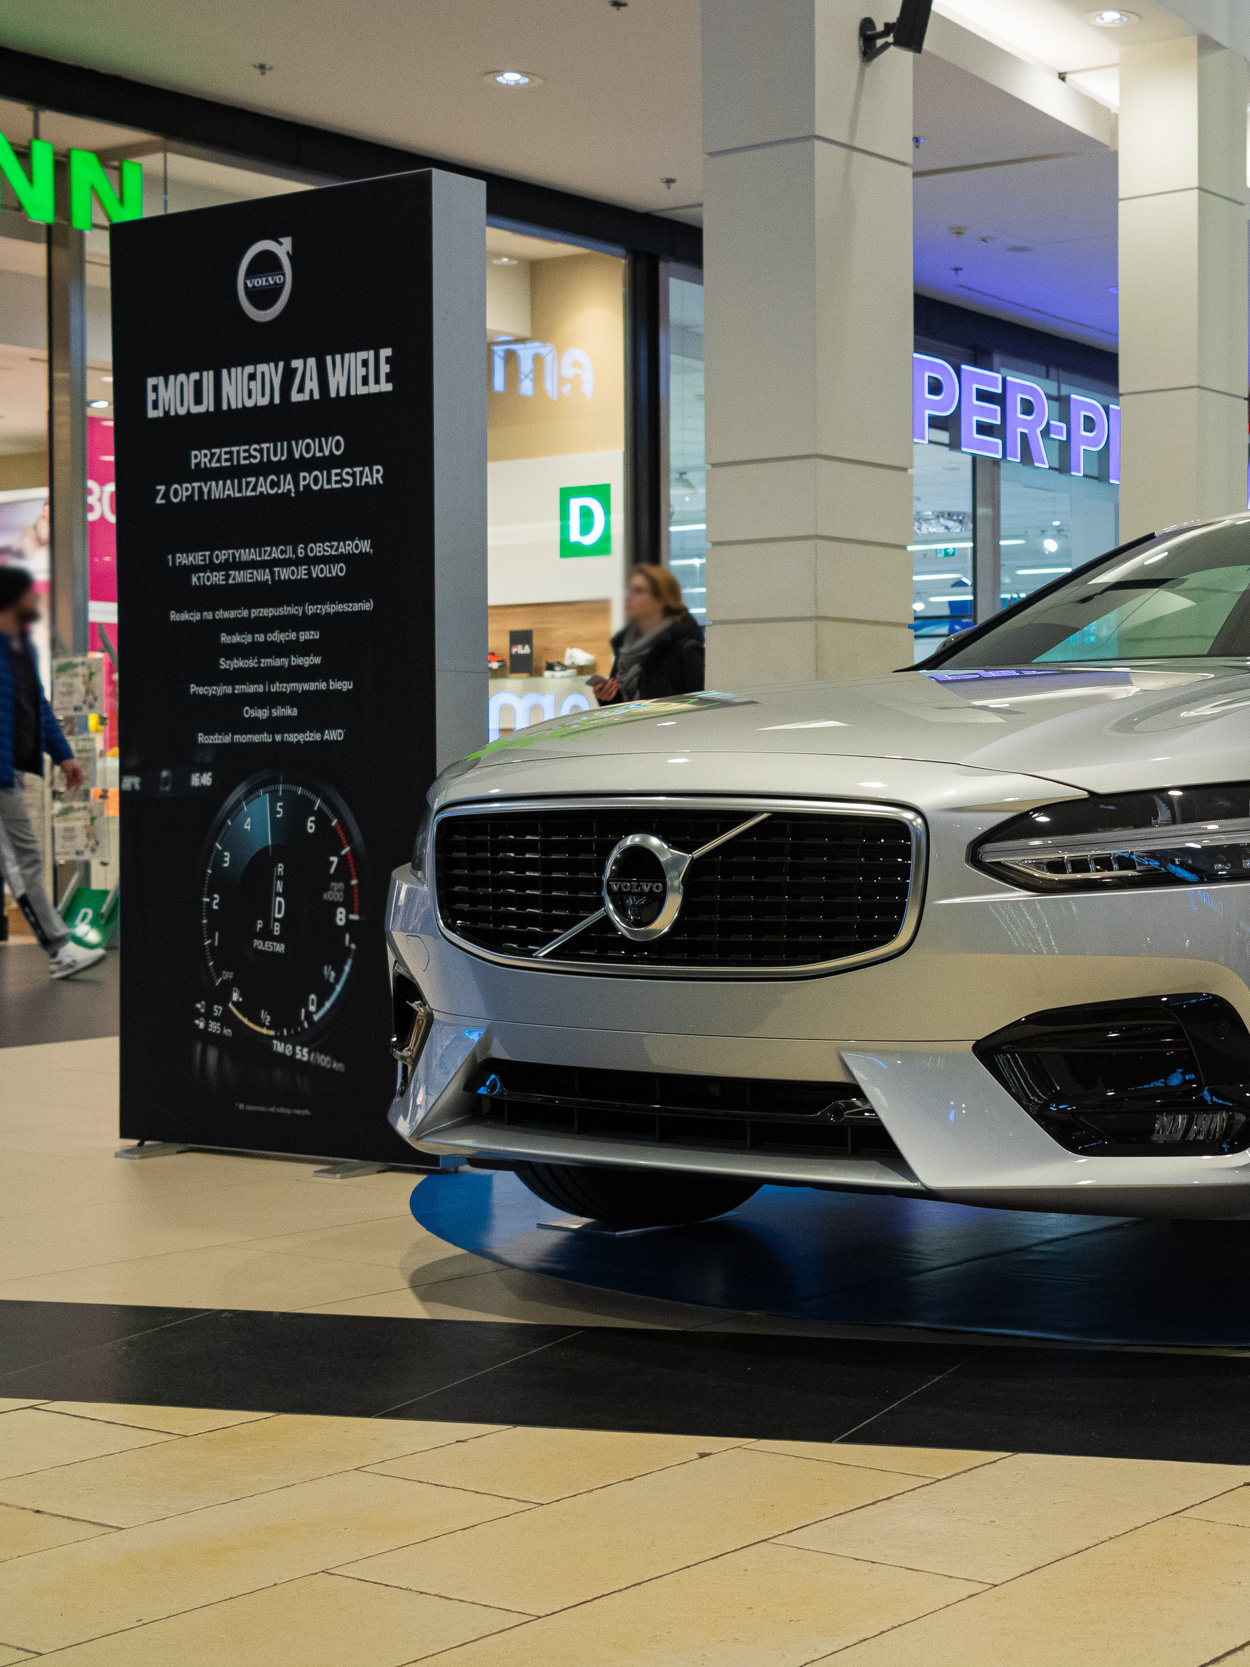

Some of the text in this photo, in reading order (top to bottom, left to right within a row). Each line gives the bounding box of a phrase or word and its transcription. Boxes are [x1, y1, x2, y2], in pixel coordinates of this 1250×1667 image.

[246, 274, 285, 288] VOLVO
[146, 348, 393, 419] EMOCJI NIGDY ZA WIELE
[191, 436, 345, 470] PRZETESTUJ VOLVO
[156, 466, 384, 505] Z OPTYMALIZACJĄ POLESTAR
[568, 497, 605, 546] D
[168, 538, 373, 567] 1 PAKIET OPTYMALIZACJI, 6 OBSZARÓW,
[192, 563, 347, 587] KTÓRE ZMIENIĄ TWOJE VOLVO
[170, 599, 374, 623] Reakcja na otwarcie przepustnicy (przyśpieszanie)
[221, 630, 320, 645] Reakcja na odjęcie gazu
[512, 644, 531, 654] FILA
[219, 654, 322, 671] Szybkość zmiany biegów
[190, 679, 353, 697] Precyzyjna zmiana i utrzymywanie biegu
[243, 705, 298, 720] Osiągi silnika
[198, 732, 232, 745] Rozdział
[234, 734, 273, 743] momentu
[275, 734, 282, 743] w
[283, 731, 322, 745] napędzie
[276, 803, 284, 818] 5
[244, 818, 251, 831] 4
[307, 817, 315, 833] 6
[223, 852, 230, 867] 3
[329, 857, 338, 874] 7
[277, 864, 284, 876] R
[276, 881, 283, 893] N
[609, 882, 663, 893] VOLVO
[213, 894, 220, 910] 2
[275, 897, 285, 919] D
[336, 907, 346, 926] 8
[257, 920, 280, 935] P B
[253, 939, 286, 953] POLESTAR
